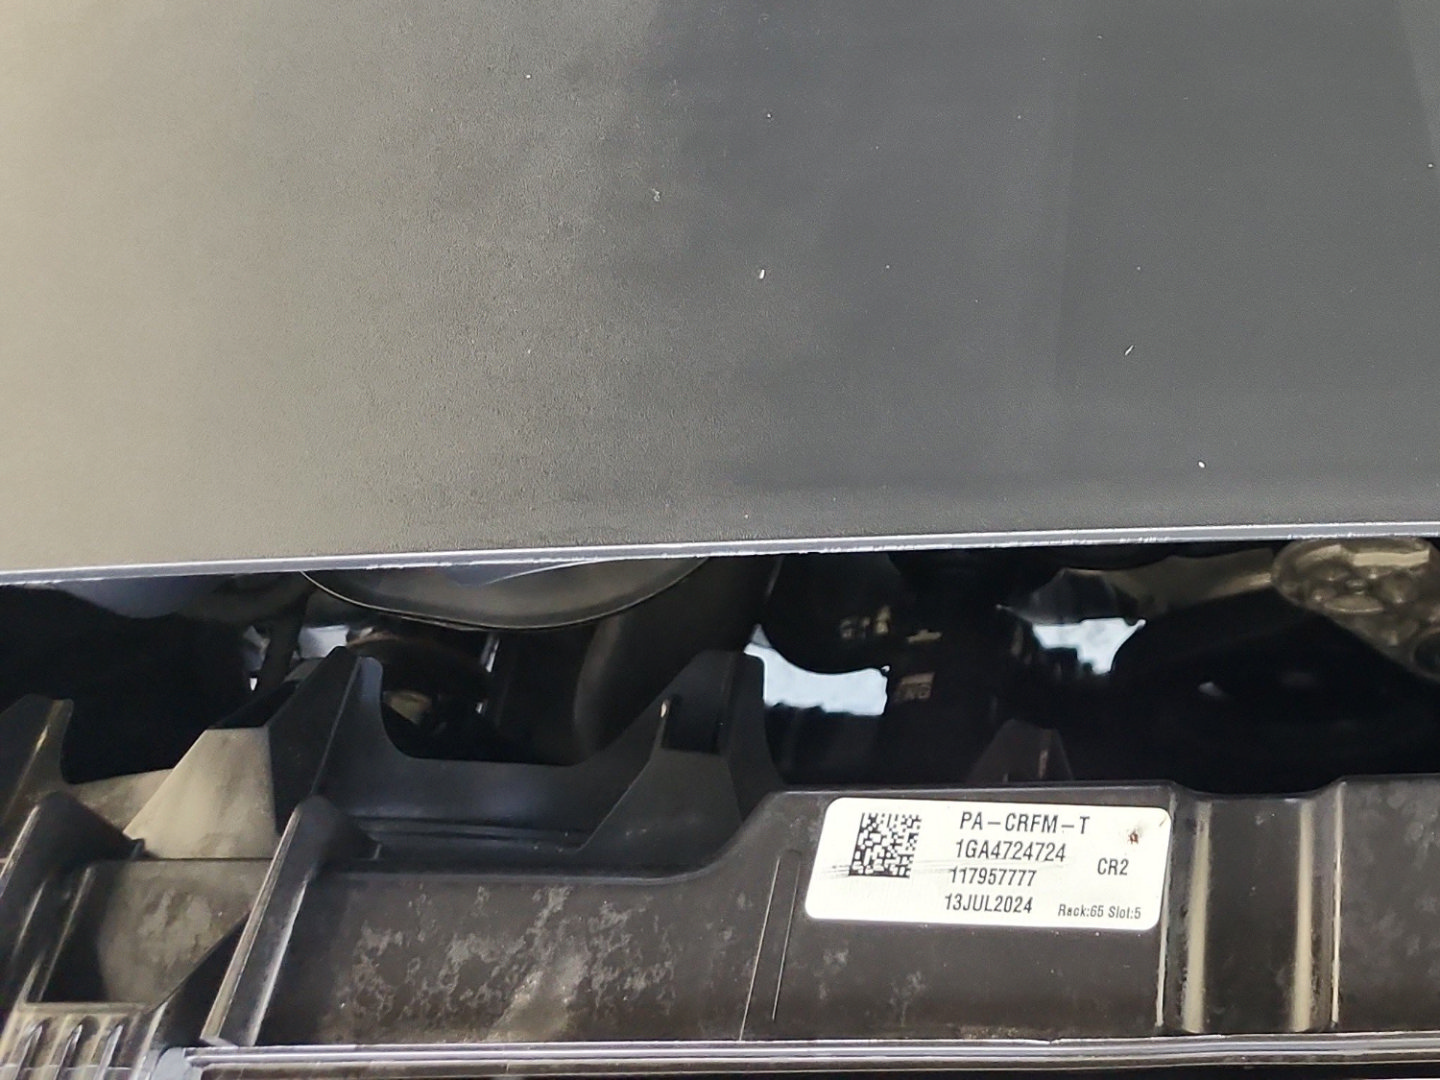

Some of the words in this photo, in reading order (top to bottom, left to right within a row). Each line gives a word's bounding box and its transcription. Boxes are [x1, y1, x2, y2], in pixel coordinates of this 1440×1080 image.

[955, 839, 1066, 862] 1GA4724724
[949, 866, 1037, 887] 117957777
[1096, 858, 1129, 876] CR2
[944, 893, 1033, 914] 13JUL2024
[1058, 903, 1104, 918] Rack:65
[1108, 905, 1142, 920] Slot:5
